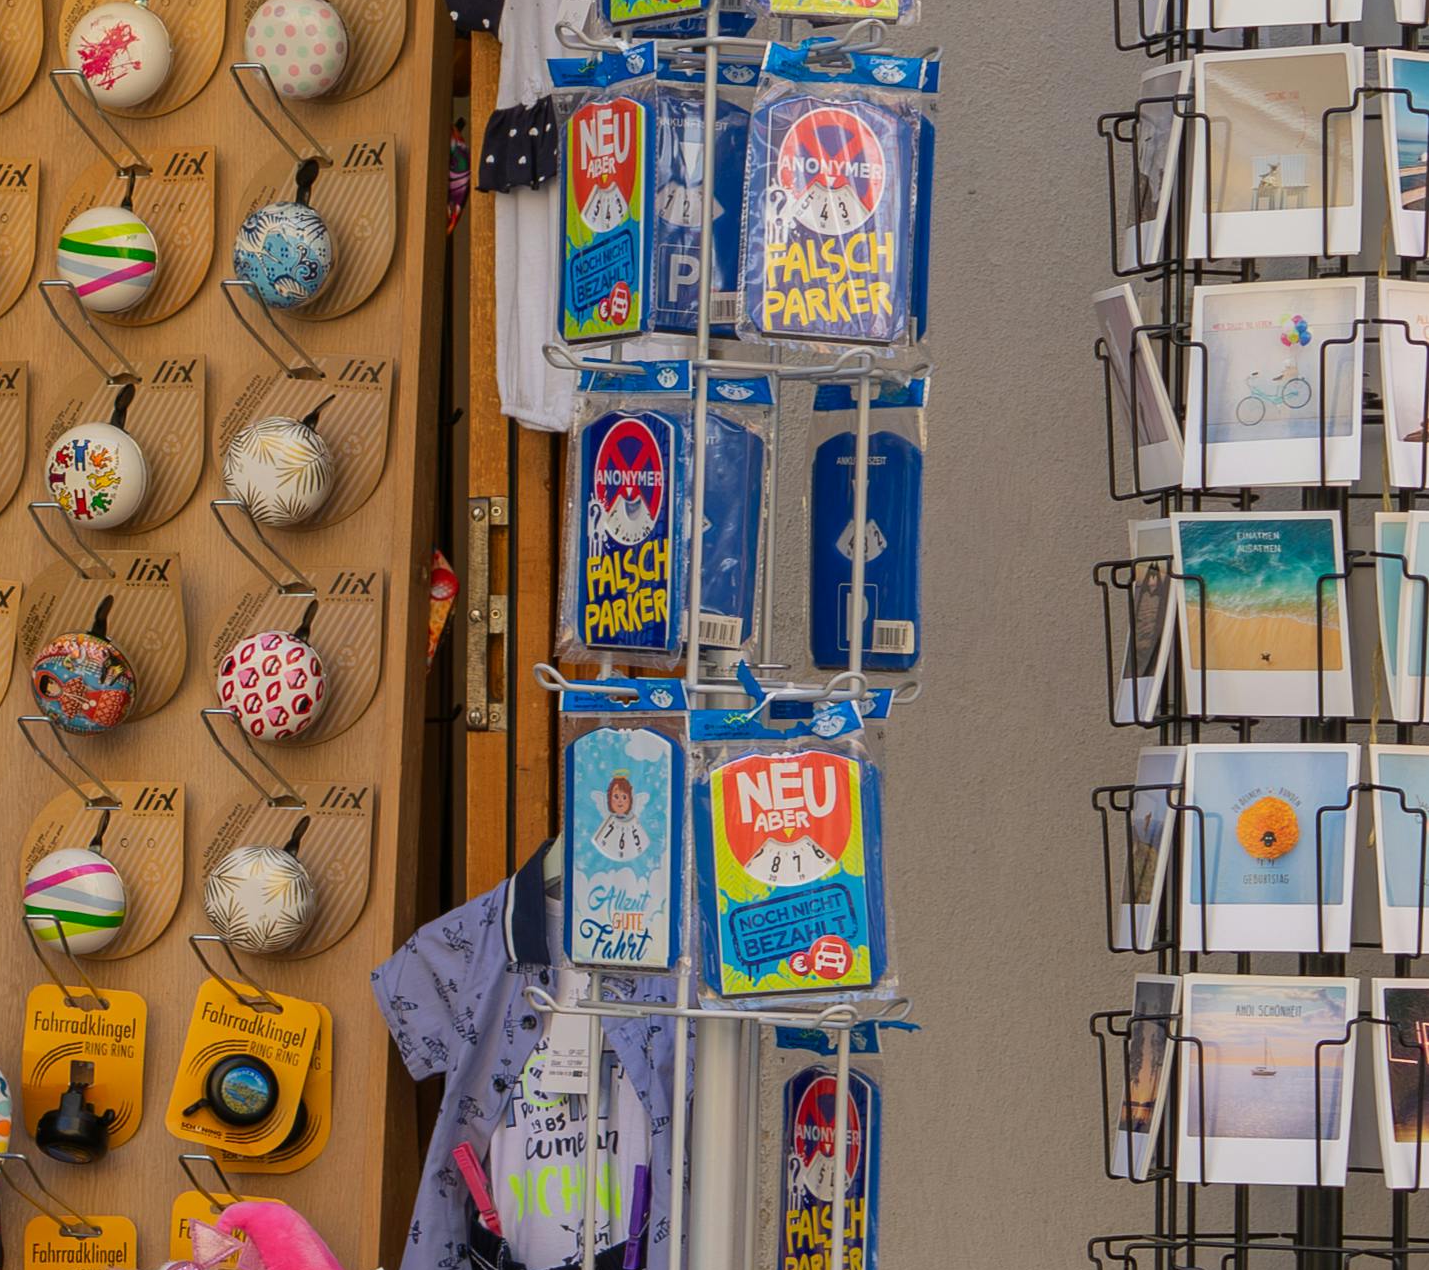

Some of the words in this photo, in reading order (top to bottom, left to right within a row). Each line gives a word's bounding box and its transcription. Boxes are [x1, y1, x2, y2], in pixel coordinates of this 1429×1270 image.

[580, 108, 631, 170] NEU
[586, 155, 616, 178] ABER
[781, 156, 882, 178] ANONYMER
[575, 253, 601, 277] NOCH
[601, 242, 630, 268] NICHT
[766, 232, 894, 288] FALSCH
[576, 261, 631, 304] BEZAHLT
[668, 254, 700, 303] P
[764, 279, 893, 331] PARKER
[595, 470, 664, 487] ANONYMER
[586, 538, 669, 603] FALSCH
[584, 588, 668, 643] PARKER
[736, 762, 836, 824] NEU
[753, 809, 810, 833] ABER
[587, 884, 651, 916] Allzeit
[739, 908, 788, 931] NOCH
[791, 893, 843, 919] NICHT
[613, 911, 644, 932] GUTE
[744, 913, 846, 957] BEZAHLT
[580, 918, 654, 962] Fahrt
[34, 1011, 136, 1043] Fahrradklingel
[202, 1001, 306, 1048] Fahrradklingel
[1235, 1005, 1255, 1017] AHOI
[84, 1041, 108, 1056] RING
[110, 1043, 134, 1059] RING
[249, 1040, 272, 1058] RING
[274, 1047, 300, 1067] RING
[32, 1243, 127, 1266] Fahrradklingel
